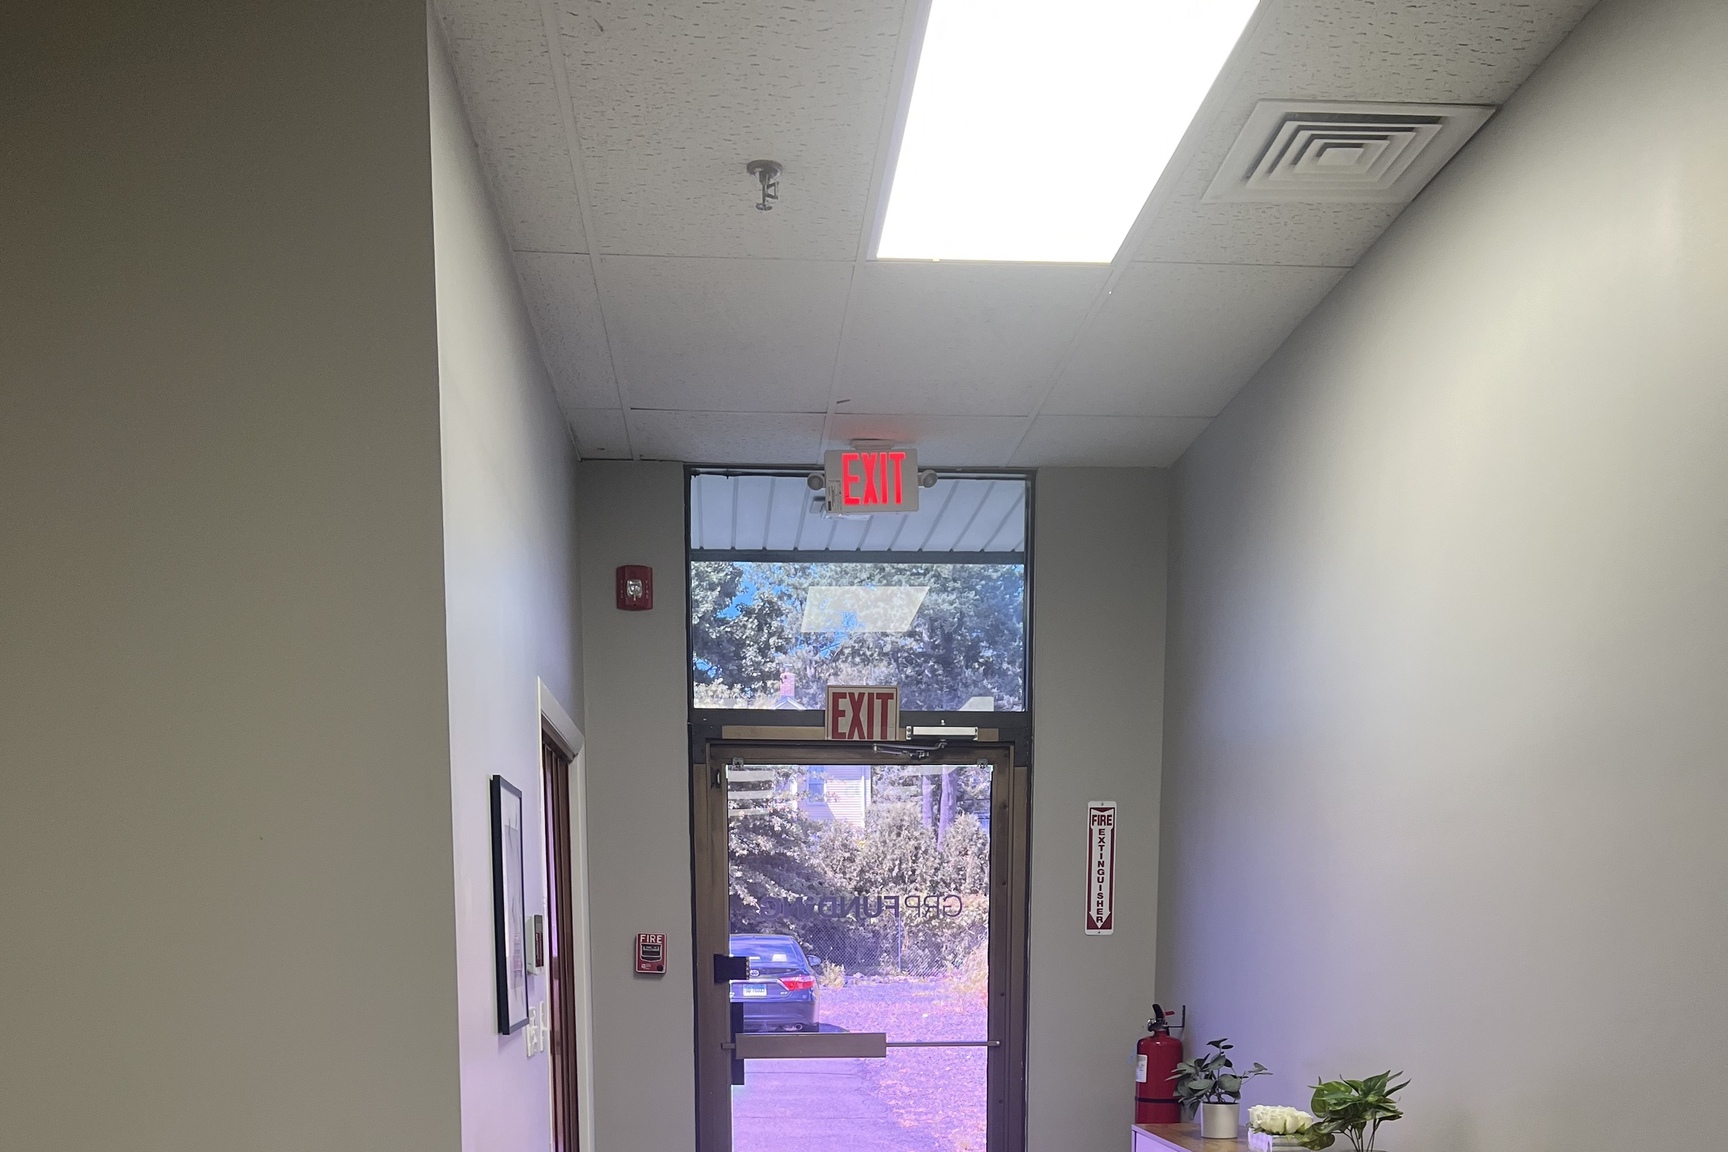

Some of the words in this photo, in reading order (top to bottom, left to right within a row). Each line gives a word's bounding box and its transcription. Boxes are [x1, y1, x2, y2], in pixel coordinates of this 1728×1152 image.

[841, 452, 906, 506] EXIT
[831, 691, 895, 740] EXIT
[1091, 814, 1113, 827] FIRE
[1096, 828, 1106, 923] EXTINGUISHER
[640, 934, 663, 944] FIRE
